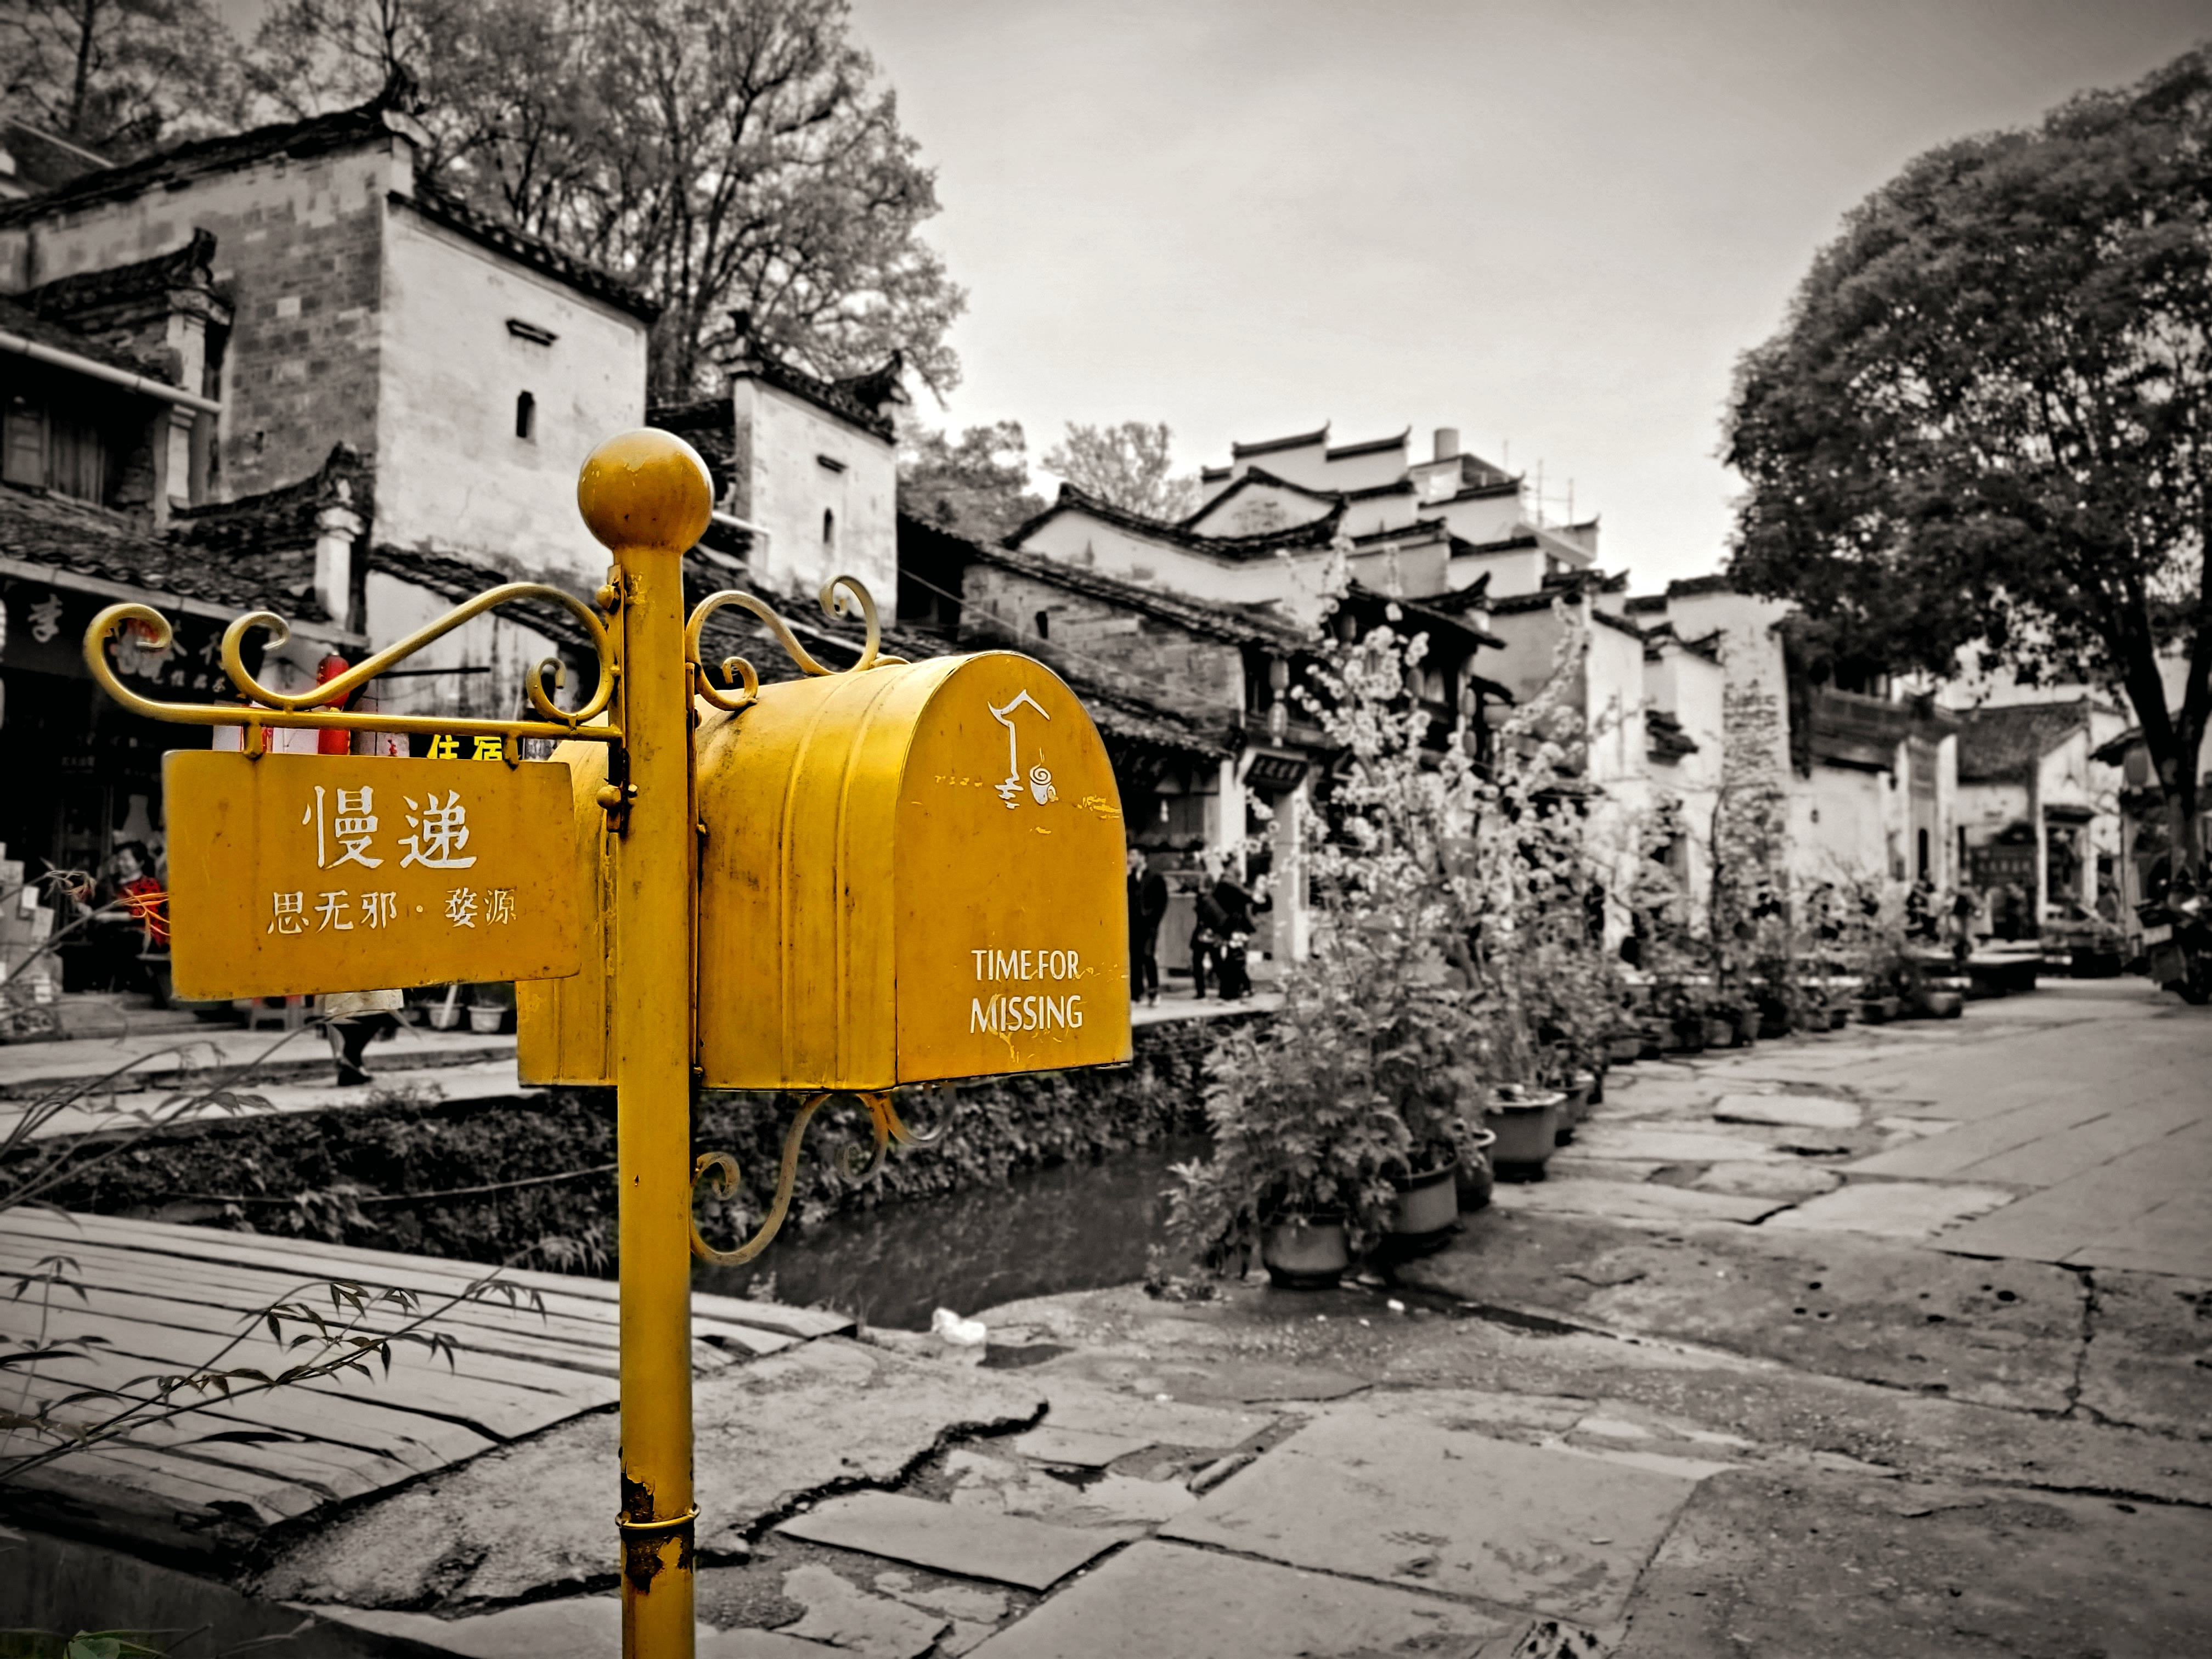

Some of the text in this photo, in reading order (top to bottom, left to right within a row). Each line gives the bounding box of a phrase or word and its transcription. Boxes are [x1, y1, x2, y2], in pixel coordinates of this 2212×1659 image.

[302, 785, 477, 870] 慢递
[970, 949, 1081, 981] TIME FOR
[969, 995, 1083, 1034] MISSING
